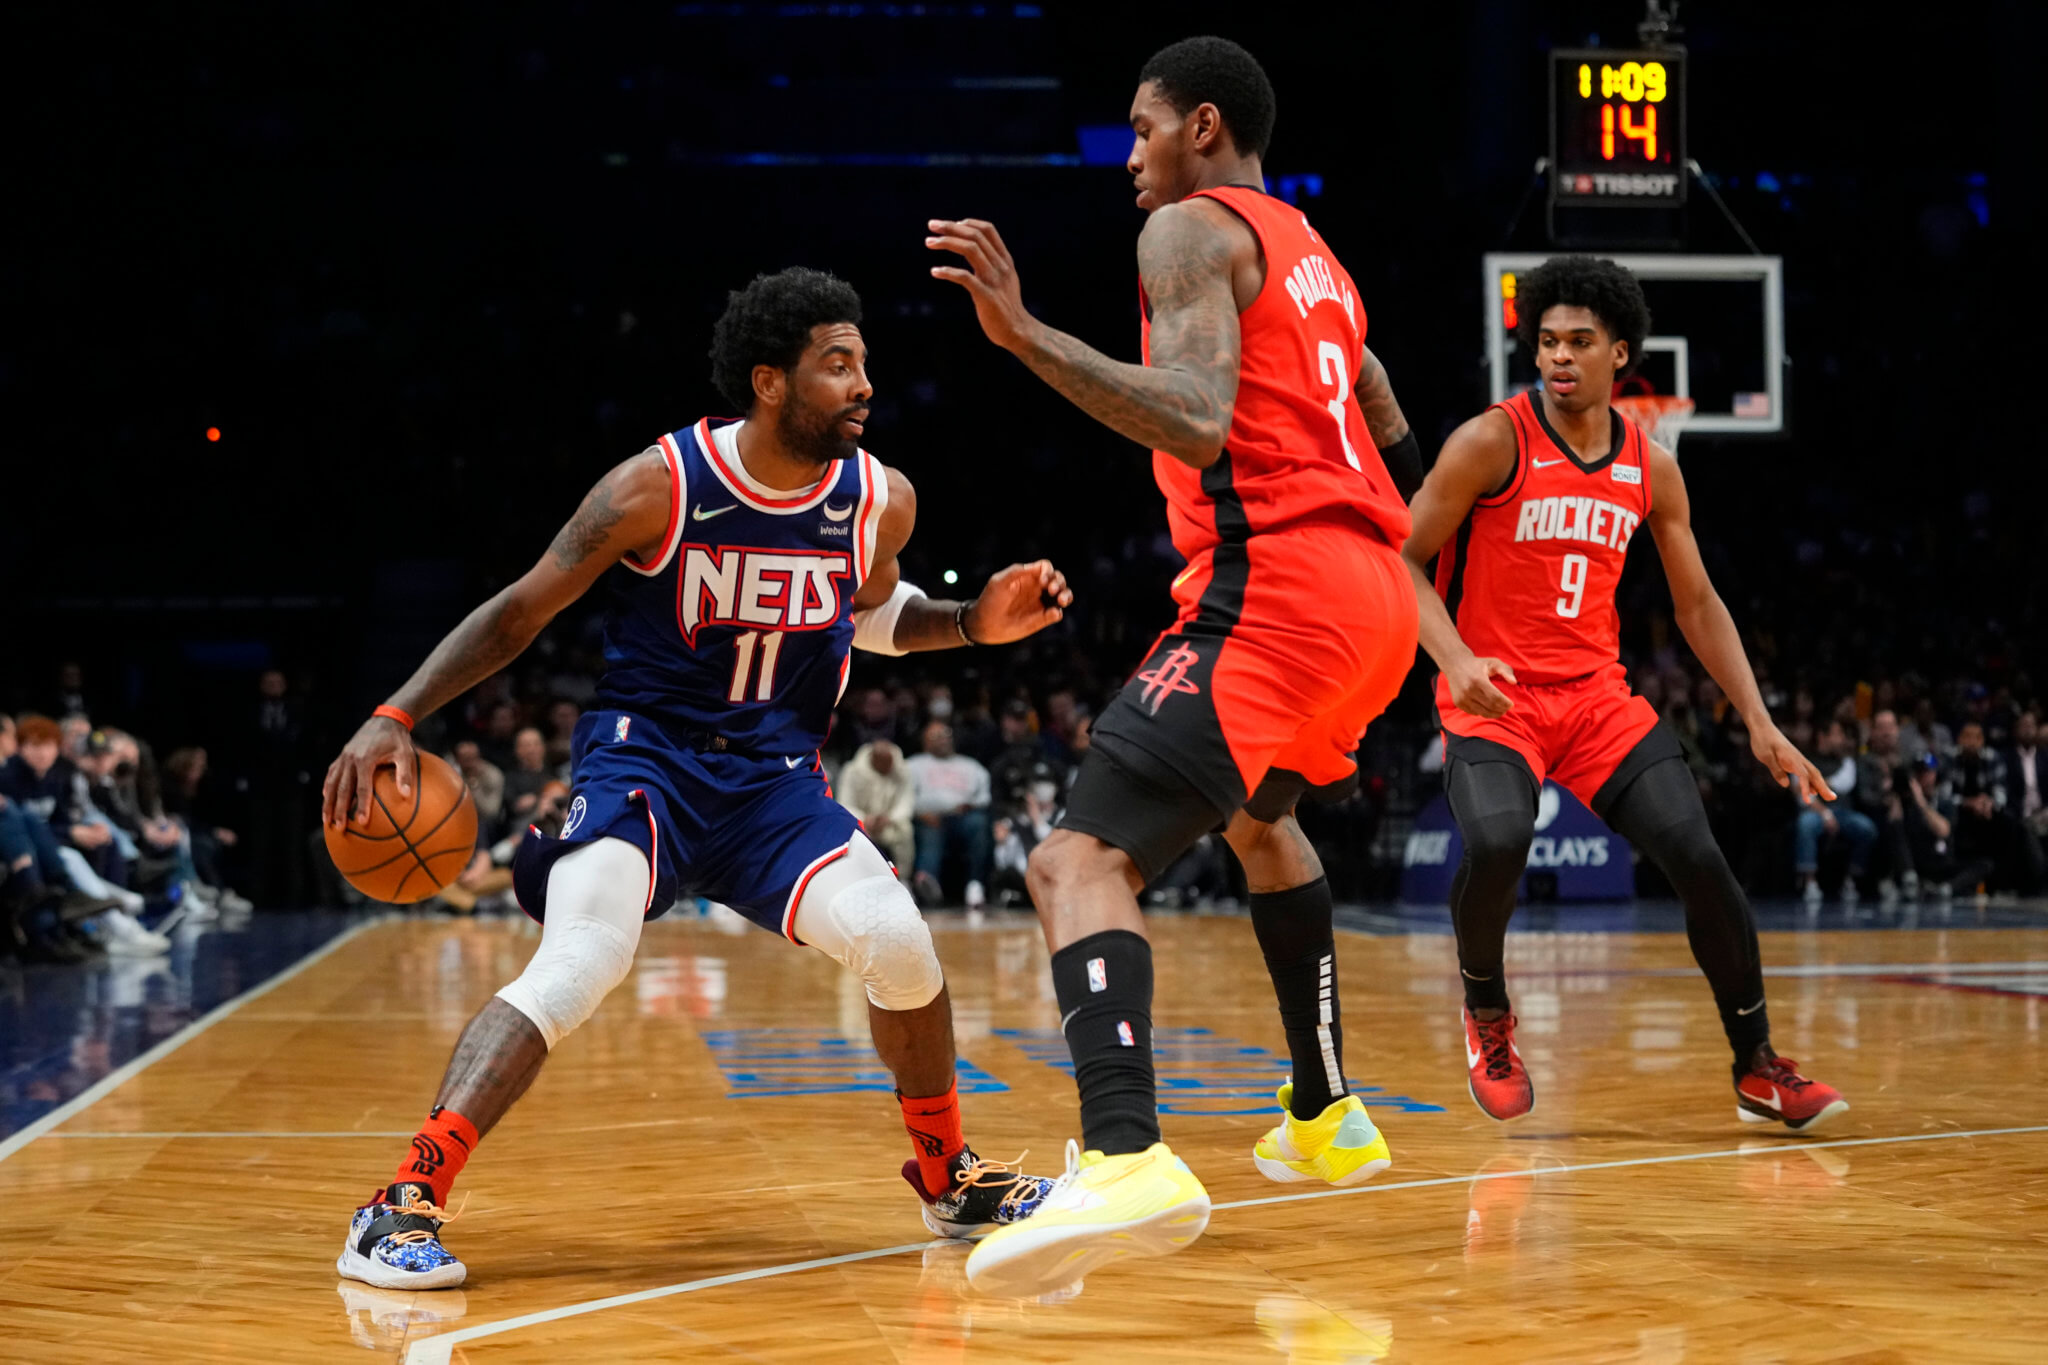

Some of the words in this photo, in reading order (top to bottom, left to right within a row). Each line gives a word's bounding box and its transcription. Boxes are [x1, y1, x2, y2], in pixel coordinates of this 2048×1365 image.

[1579, 61, 1667, 103] 11:09
[1601, 103, 1657, 161] 14
[1594, 173, 1679, 196] TISSOT
[1612, 471, 1638, 482] MONEY
[820, 526, 849, 536] Webull
[1514, 496, 1639, 554] ROCKETS
[678, 543, 851, 649] NETS
[1555, 553, 1588, 619] 9
[727, 630, 784, 704] 11
[1526, 836, 1610, 867] CLAYS
